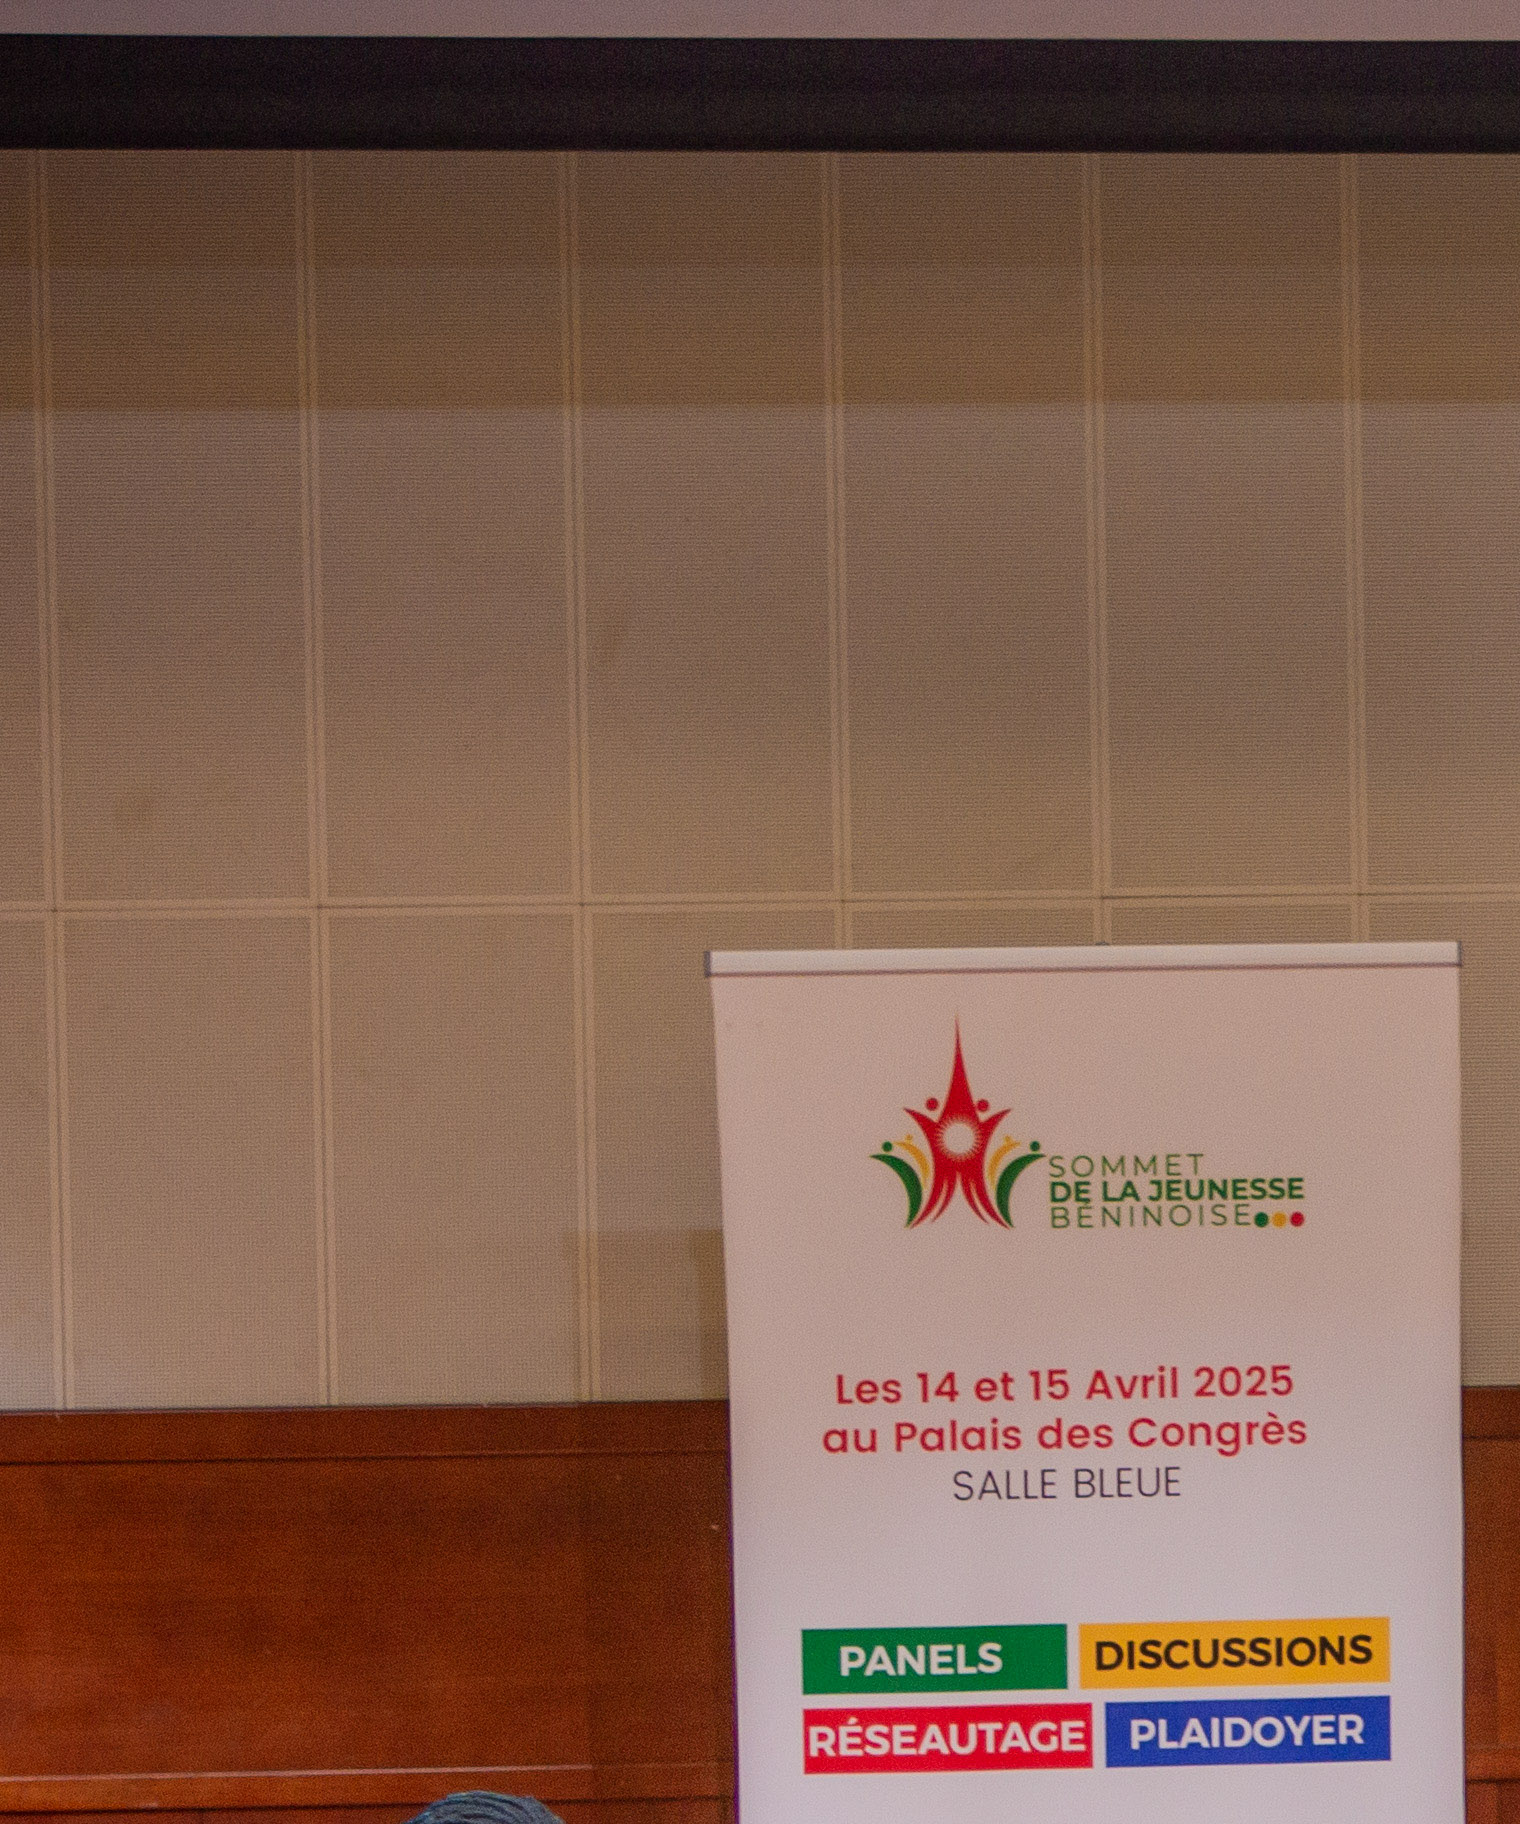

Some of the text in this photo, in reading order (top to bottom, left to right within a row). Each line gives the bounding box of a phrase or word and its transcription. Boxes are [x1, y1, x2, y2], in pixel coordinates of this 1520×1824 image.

[1049, 1153, 1204, 1178] SOMMET
[1050, 1177, 1304, 1203] DE LA JEUNESSE
[834, 1365, 1294, 1405] Les 14 et 15 Avril 2025
[822, 1411, 1308, 1458] au Palais des Congrès
[952, 1466, 1182, 1501] SALLE BLEUE
[839, 1641, 1003, 1677] PANELS
[1095, 1634, 1374, 1672] DISCUSSIONS
[808, 1717, 1086, 1757] RÉSEAUTAGE
[1130, 1713, 1365, 1751] PLAIDOYER
